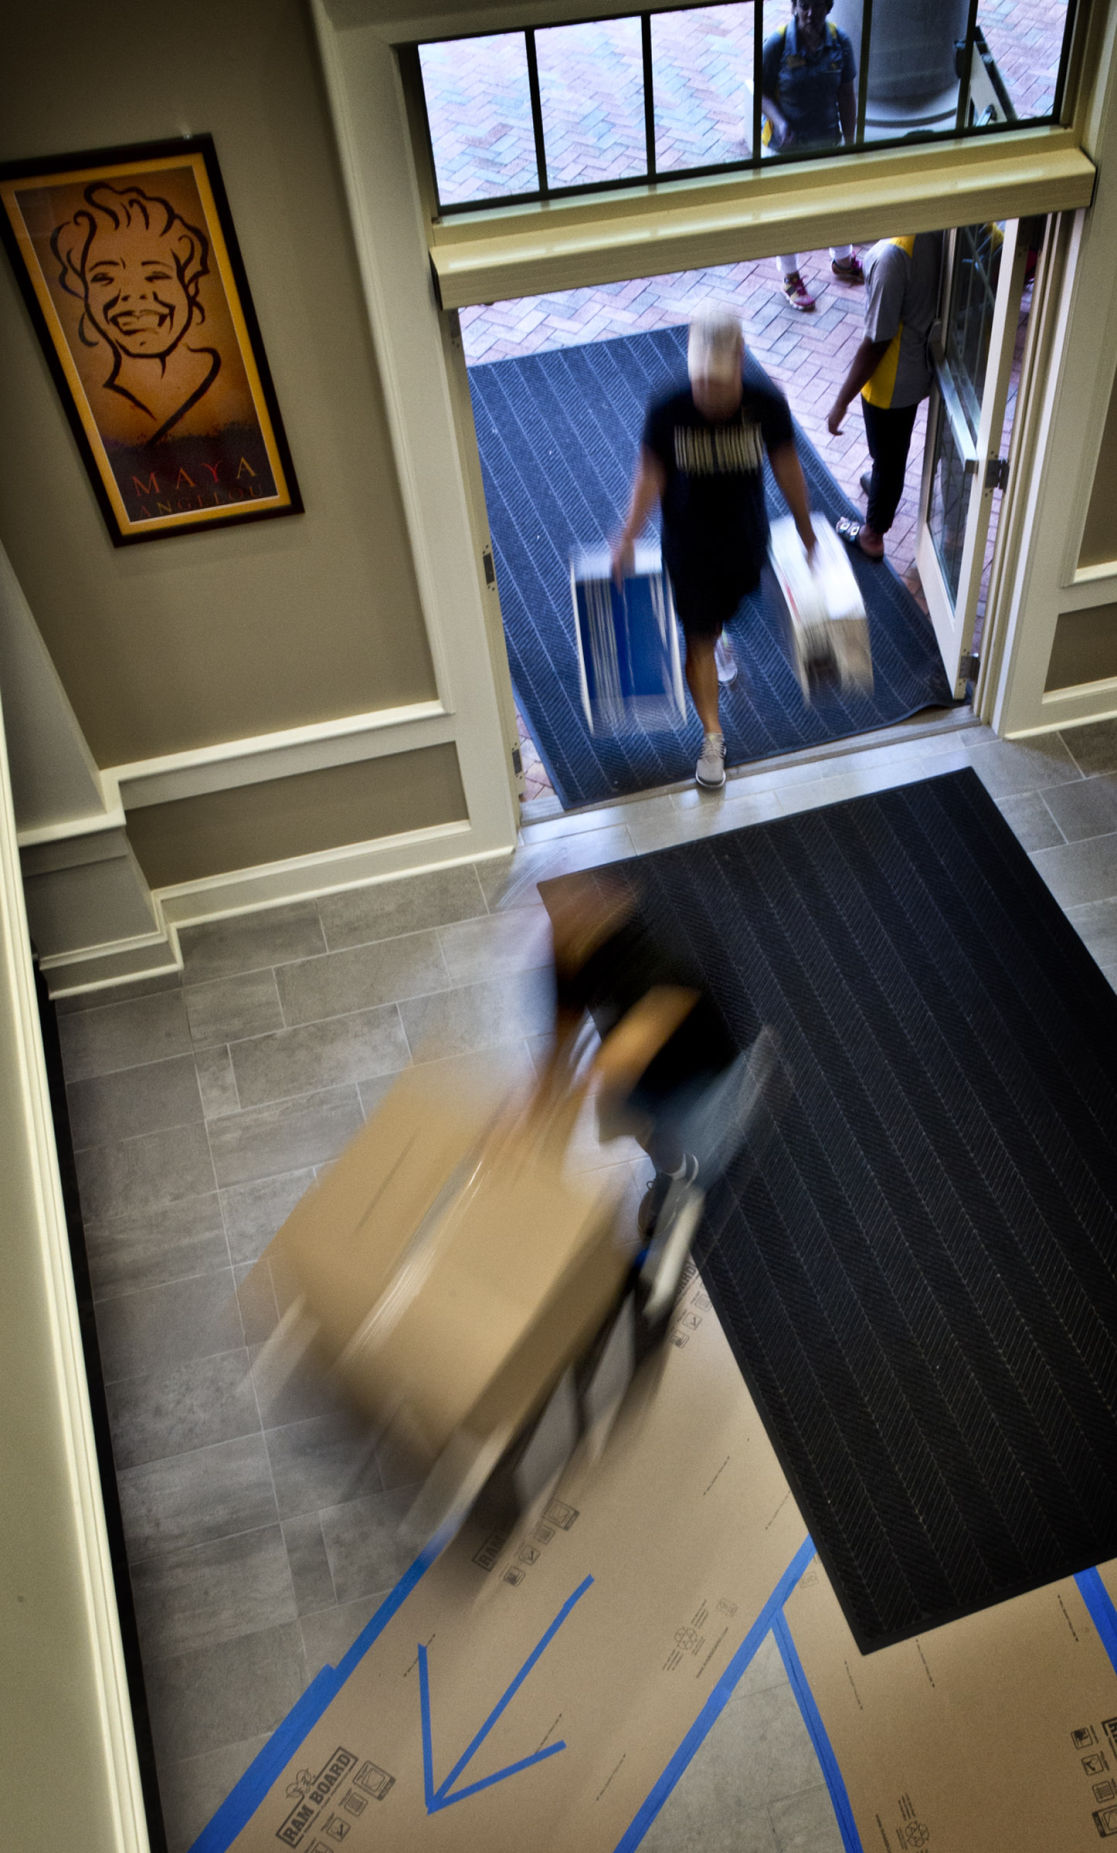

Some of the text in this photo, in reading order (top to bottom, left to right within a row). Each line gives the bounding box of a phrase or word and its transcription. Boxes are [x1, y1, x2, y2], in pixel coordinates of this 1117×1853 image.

[131, 456, 256, 497] MAYA
[282, 1753, 351, 1842] RAM BOARD
